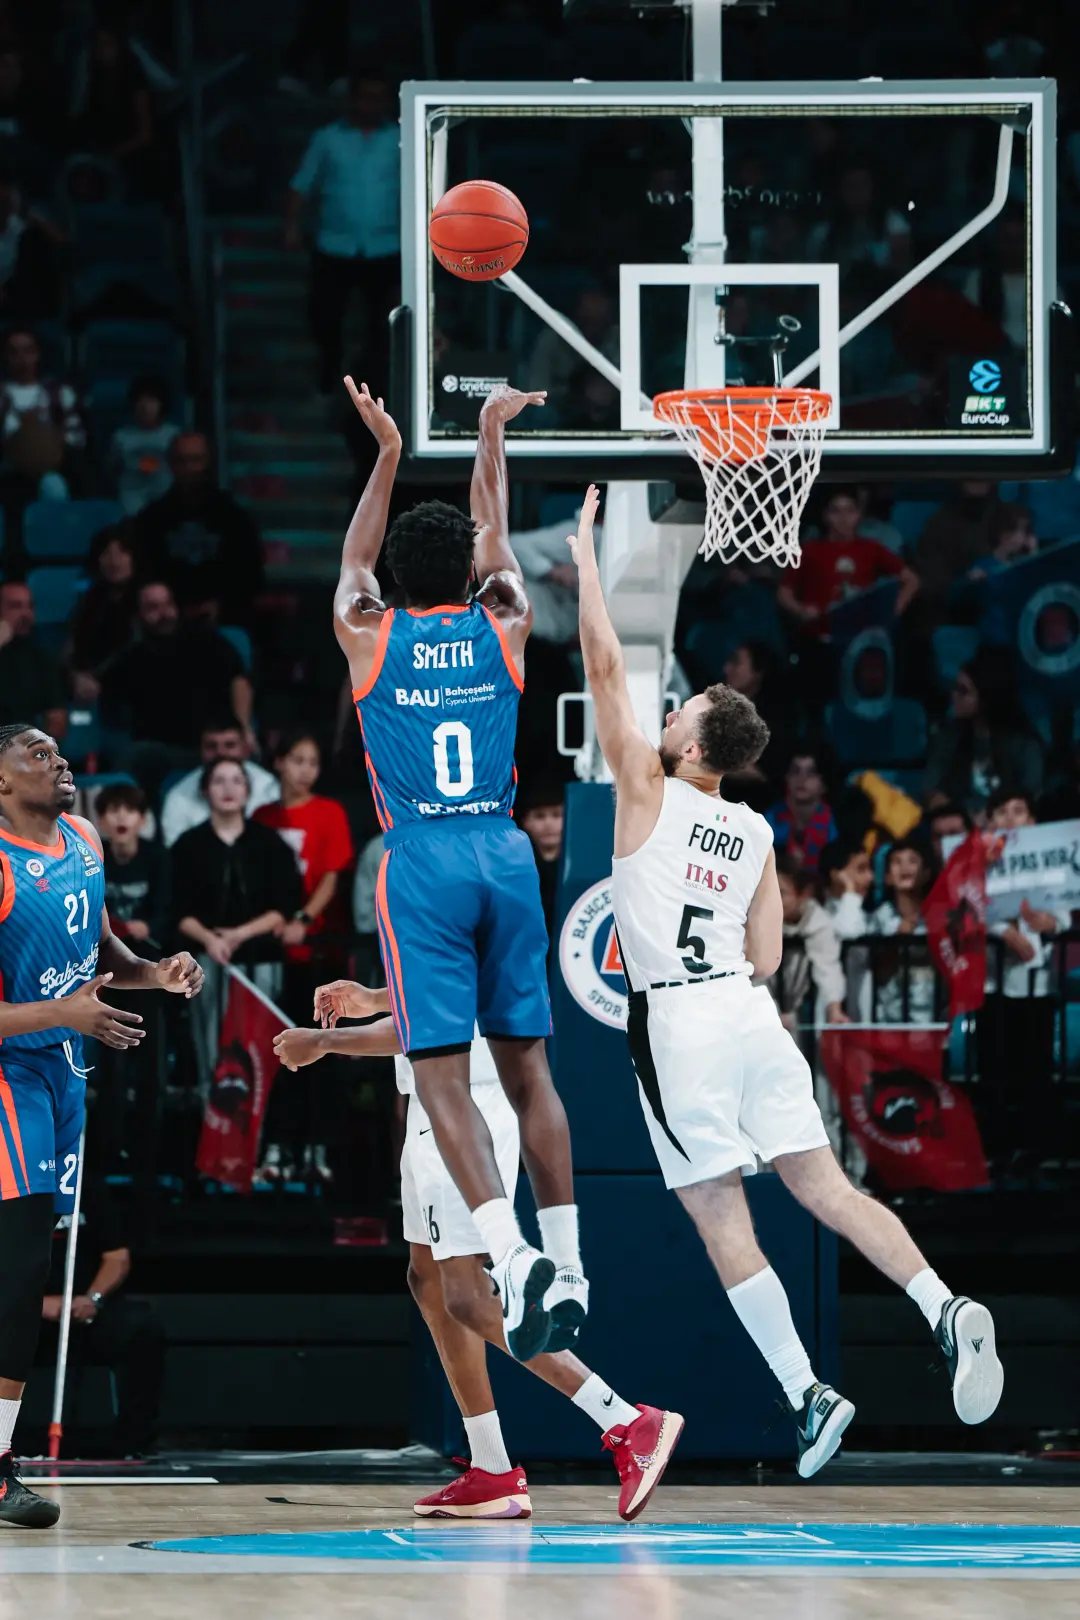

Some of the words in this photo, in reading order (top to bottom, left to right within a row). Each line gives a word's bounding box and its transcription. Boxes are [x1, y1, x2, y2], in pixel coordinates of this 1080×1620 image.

[961, 413, 1010, 426] EuroCup
[413, 640, 474, 669] SMITH
[395, 688, 440, 707] BAU
[445, 683, 496, 698] Bahçeşehir
[445, 696, 468, 707] Cyprus
[433, 721, 474, 797] 0
[688, 823, 744, 862] FORD
[685, 862, 729, 892] ITAS
[64, 888, 89, 936] 21
[676, 904, 714, 974] 5
[588, 990, 623, 1018] SPOR
[59, 1153, 80, 1195] 2
[423, 1205, 440, 1244] 6
